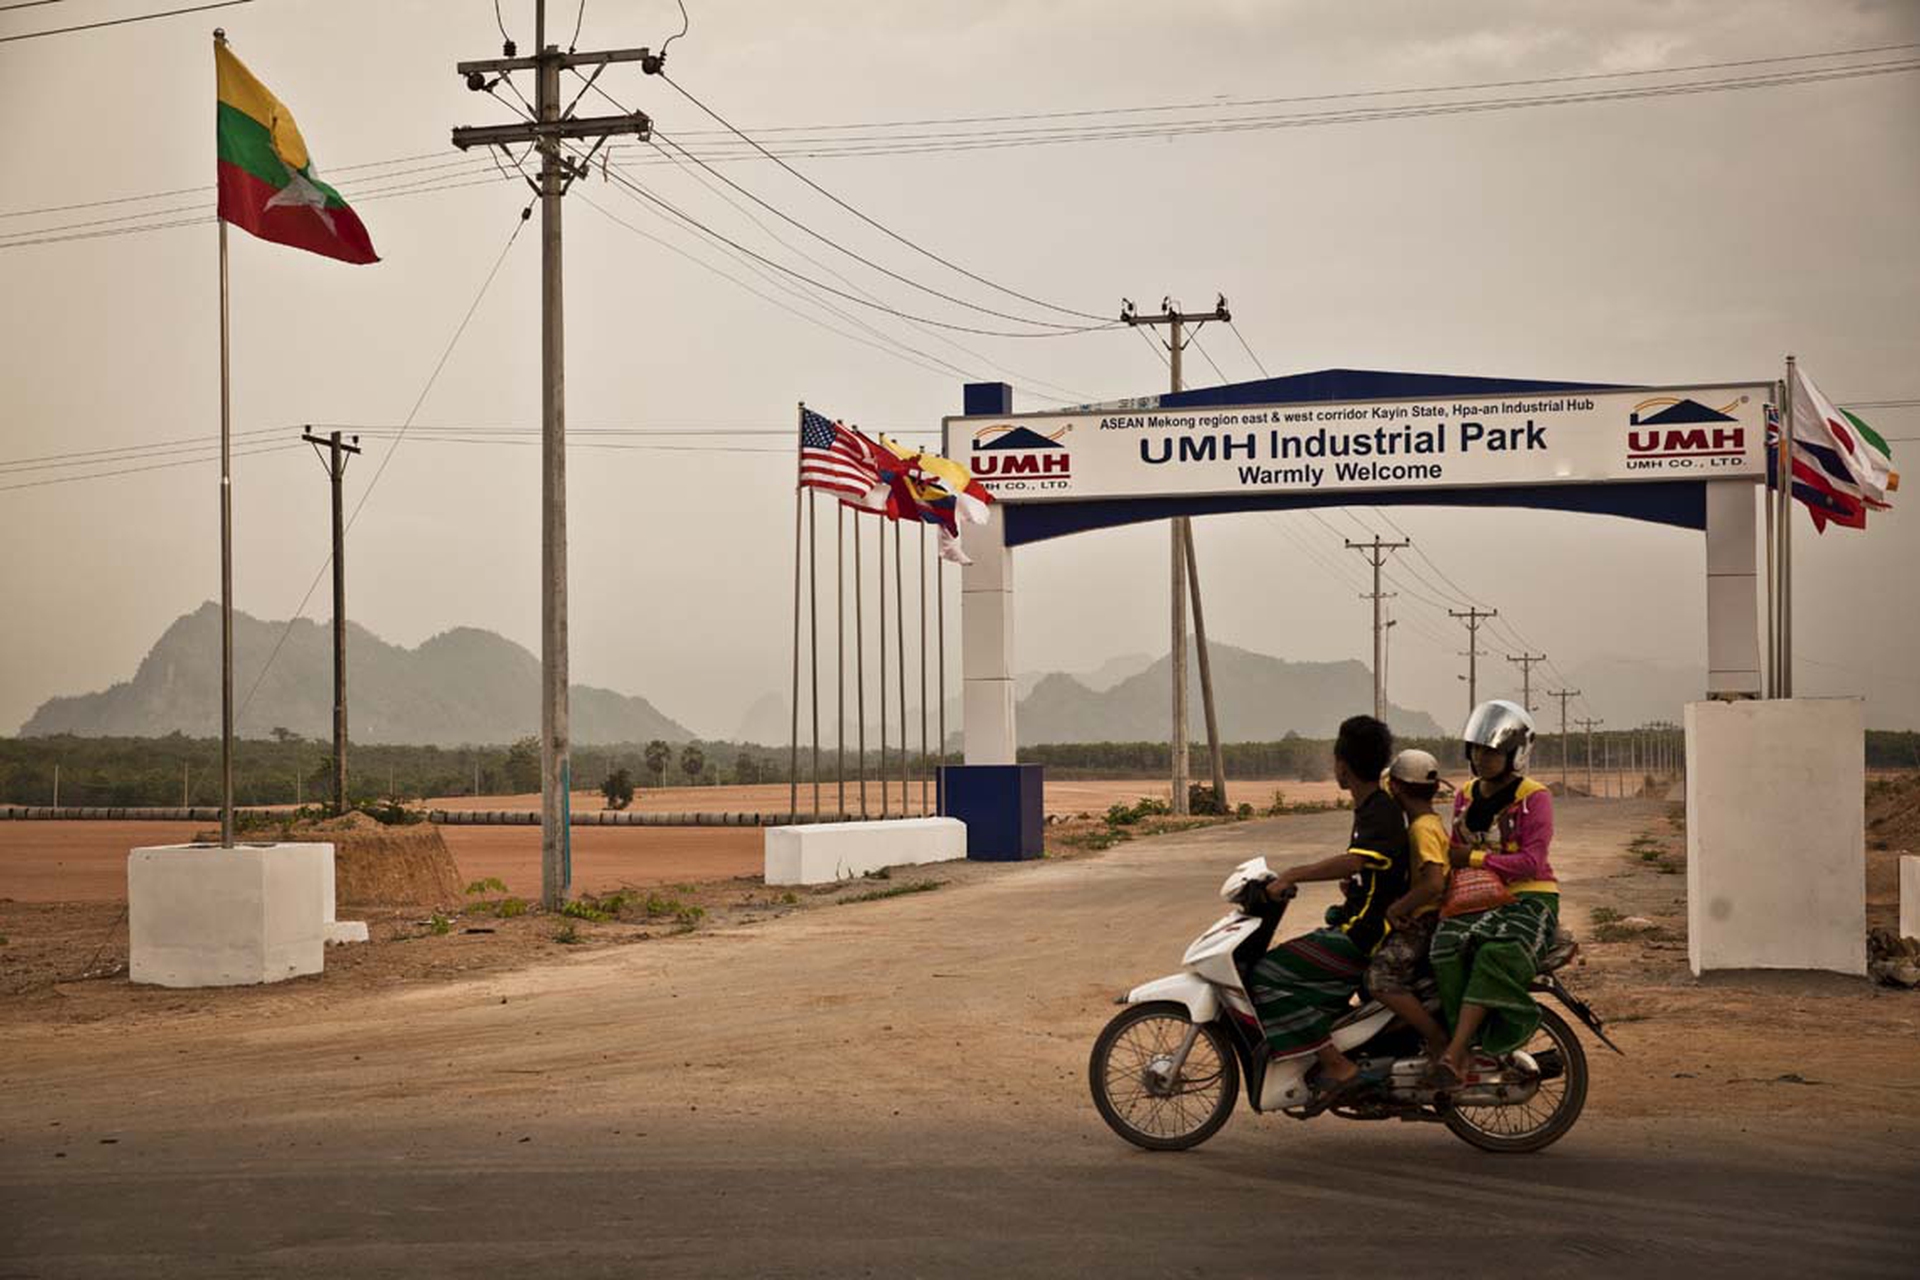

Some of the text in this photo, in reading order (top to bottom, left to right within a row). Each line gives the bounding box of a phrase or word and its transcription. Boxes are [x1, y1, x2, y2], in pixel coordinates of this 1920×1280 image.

[1100, 398, 1595, 430] ASEAN Mekong region east & west corridor Kayin State, Hpa-an Industrial Hub
[1140, 420, 1548, 464] UMH Industrial Park
[1628, 428, 1744, 451] UMH
[971, 454, 1070, 475] UMH
[1238, 462, 1442, 487] Warmly Welcome
[1626, 461, 1662, 470] UMH
